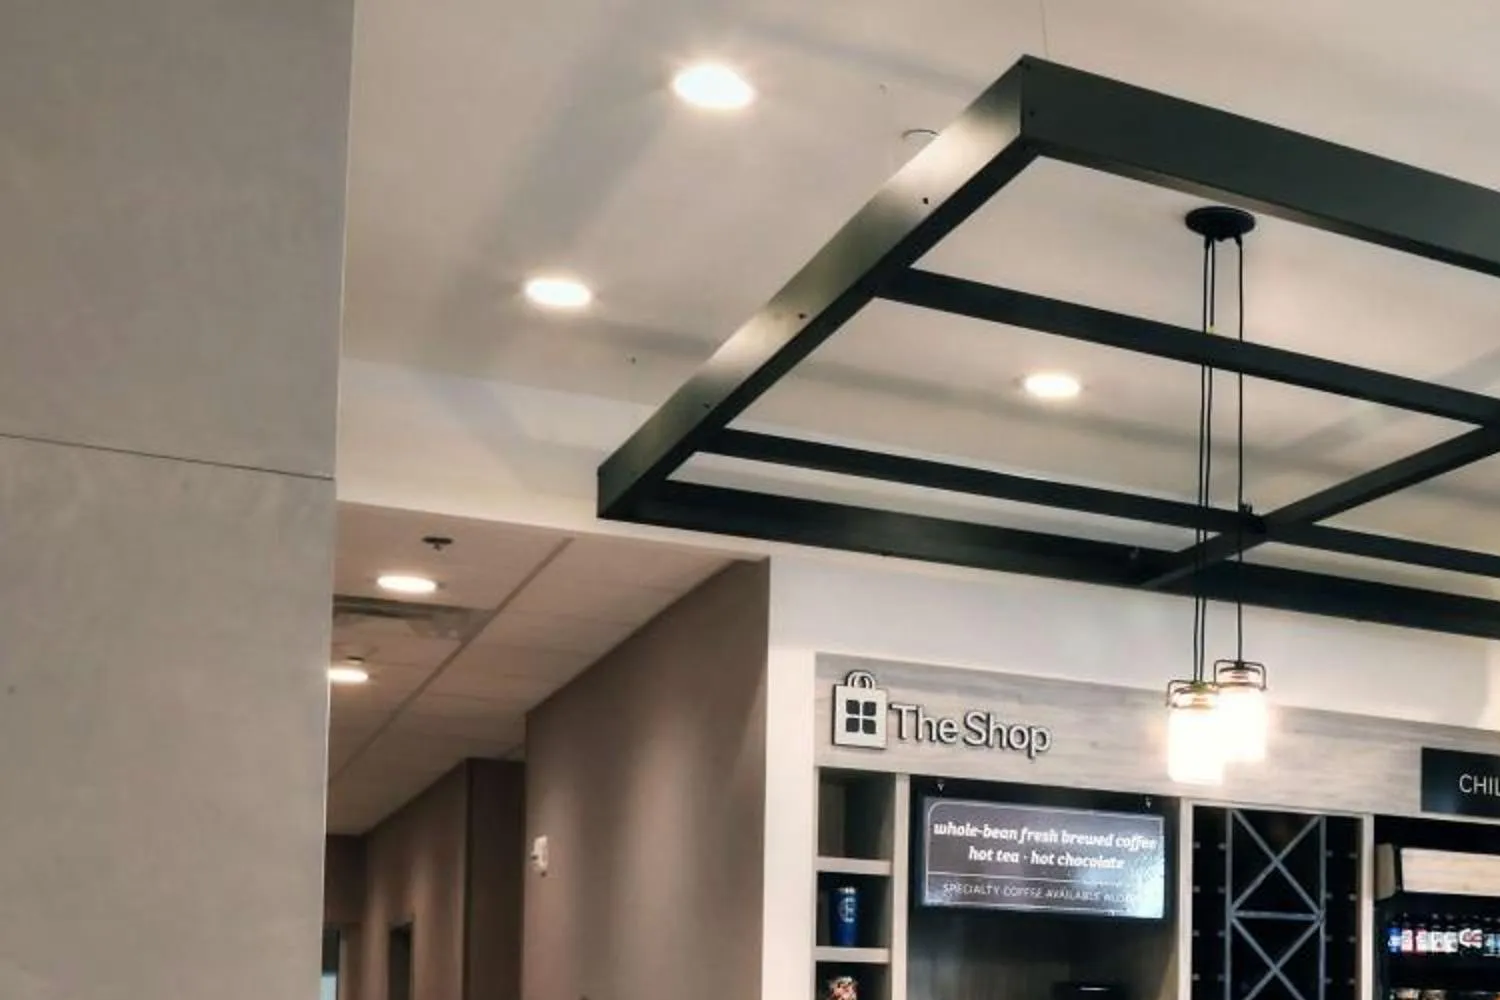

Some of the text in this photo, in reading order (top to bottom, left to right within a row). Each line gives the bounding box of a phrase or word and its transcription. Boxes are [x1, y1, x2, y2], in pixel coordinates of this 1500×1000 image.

[888, 702, 1051, 760] The Shop
[933, 821, 1157, 852] whole-bean fresh brewed coffee
[968, 845, 1124, 869] hot tea hot chocolate
[943, 883, 1000, 897] SPECIALTY
[1003, 885, 1042, 898] COFFEE
